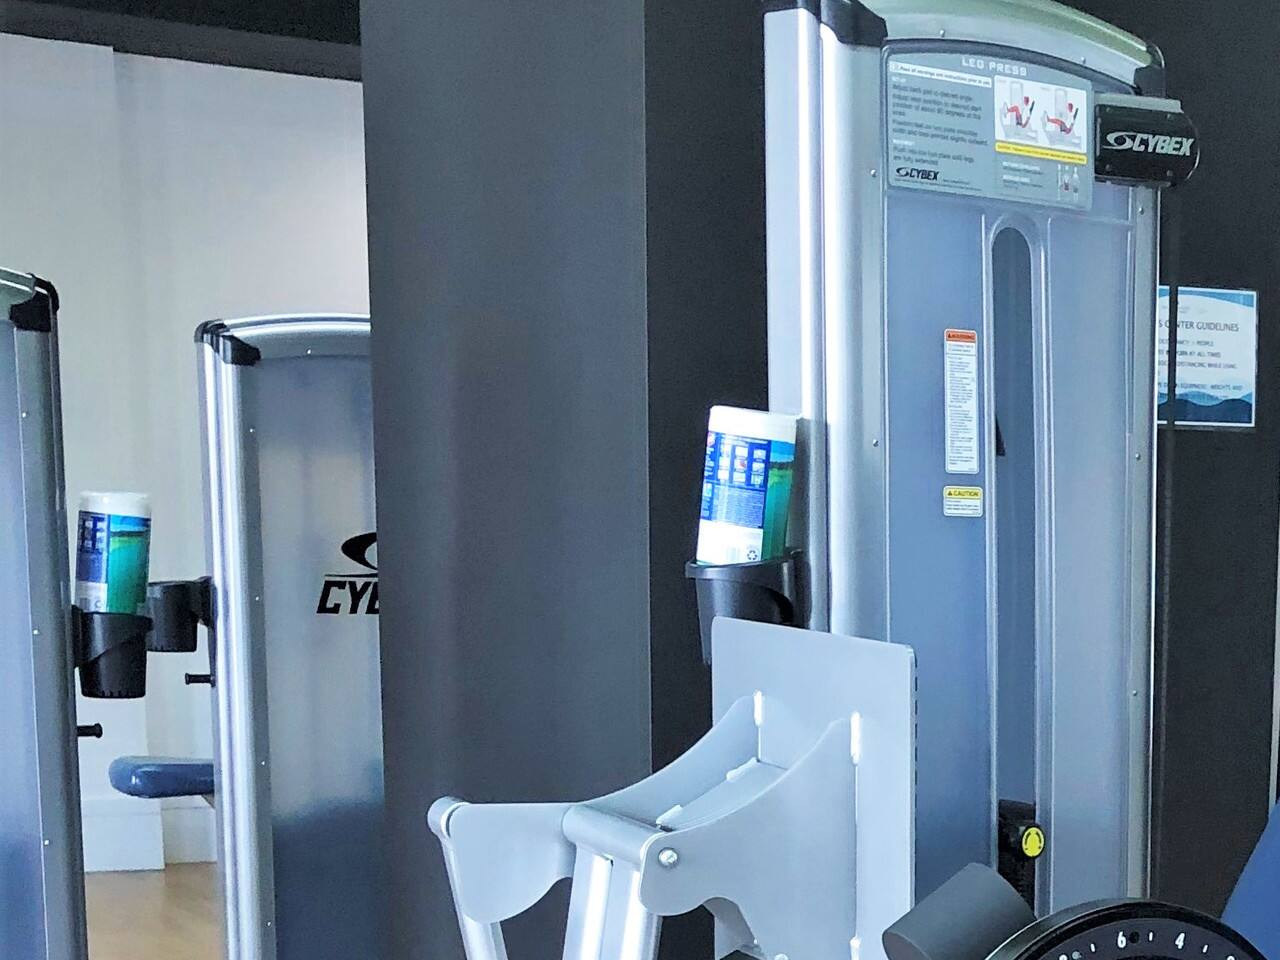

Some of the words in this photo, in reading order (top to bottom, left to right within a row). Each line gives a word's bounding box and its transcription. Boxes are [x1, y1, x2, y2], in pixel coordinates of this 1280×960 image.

[962, 57, 984, 69] LEG
[989, 62, 1027, 76] PRESS
[1132, 132, 1195, 156] CYBEX
[909, 168, 939, 180] CYBEX
[1117, 931, 1127, 949] 6
[1175, 932, 1186, 950] 4
